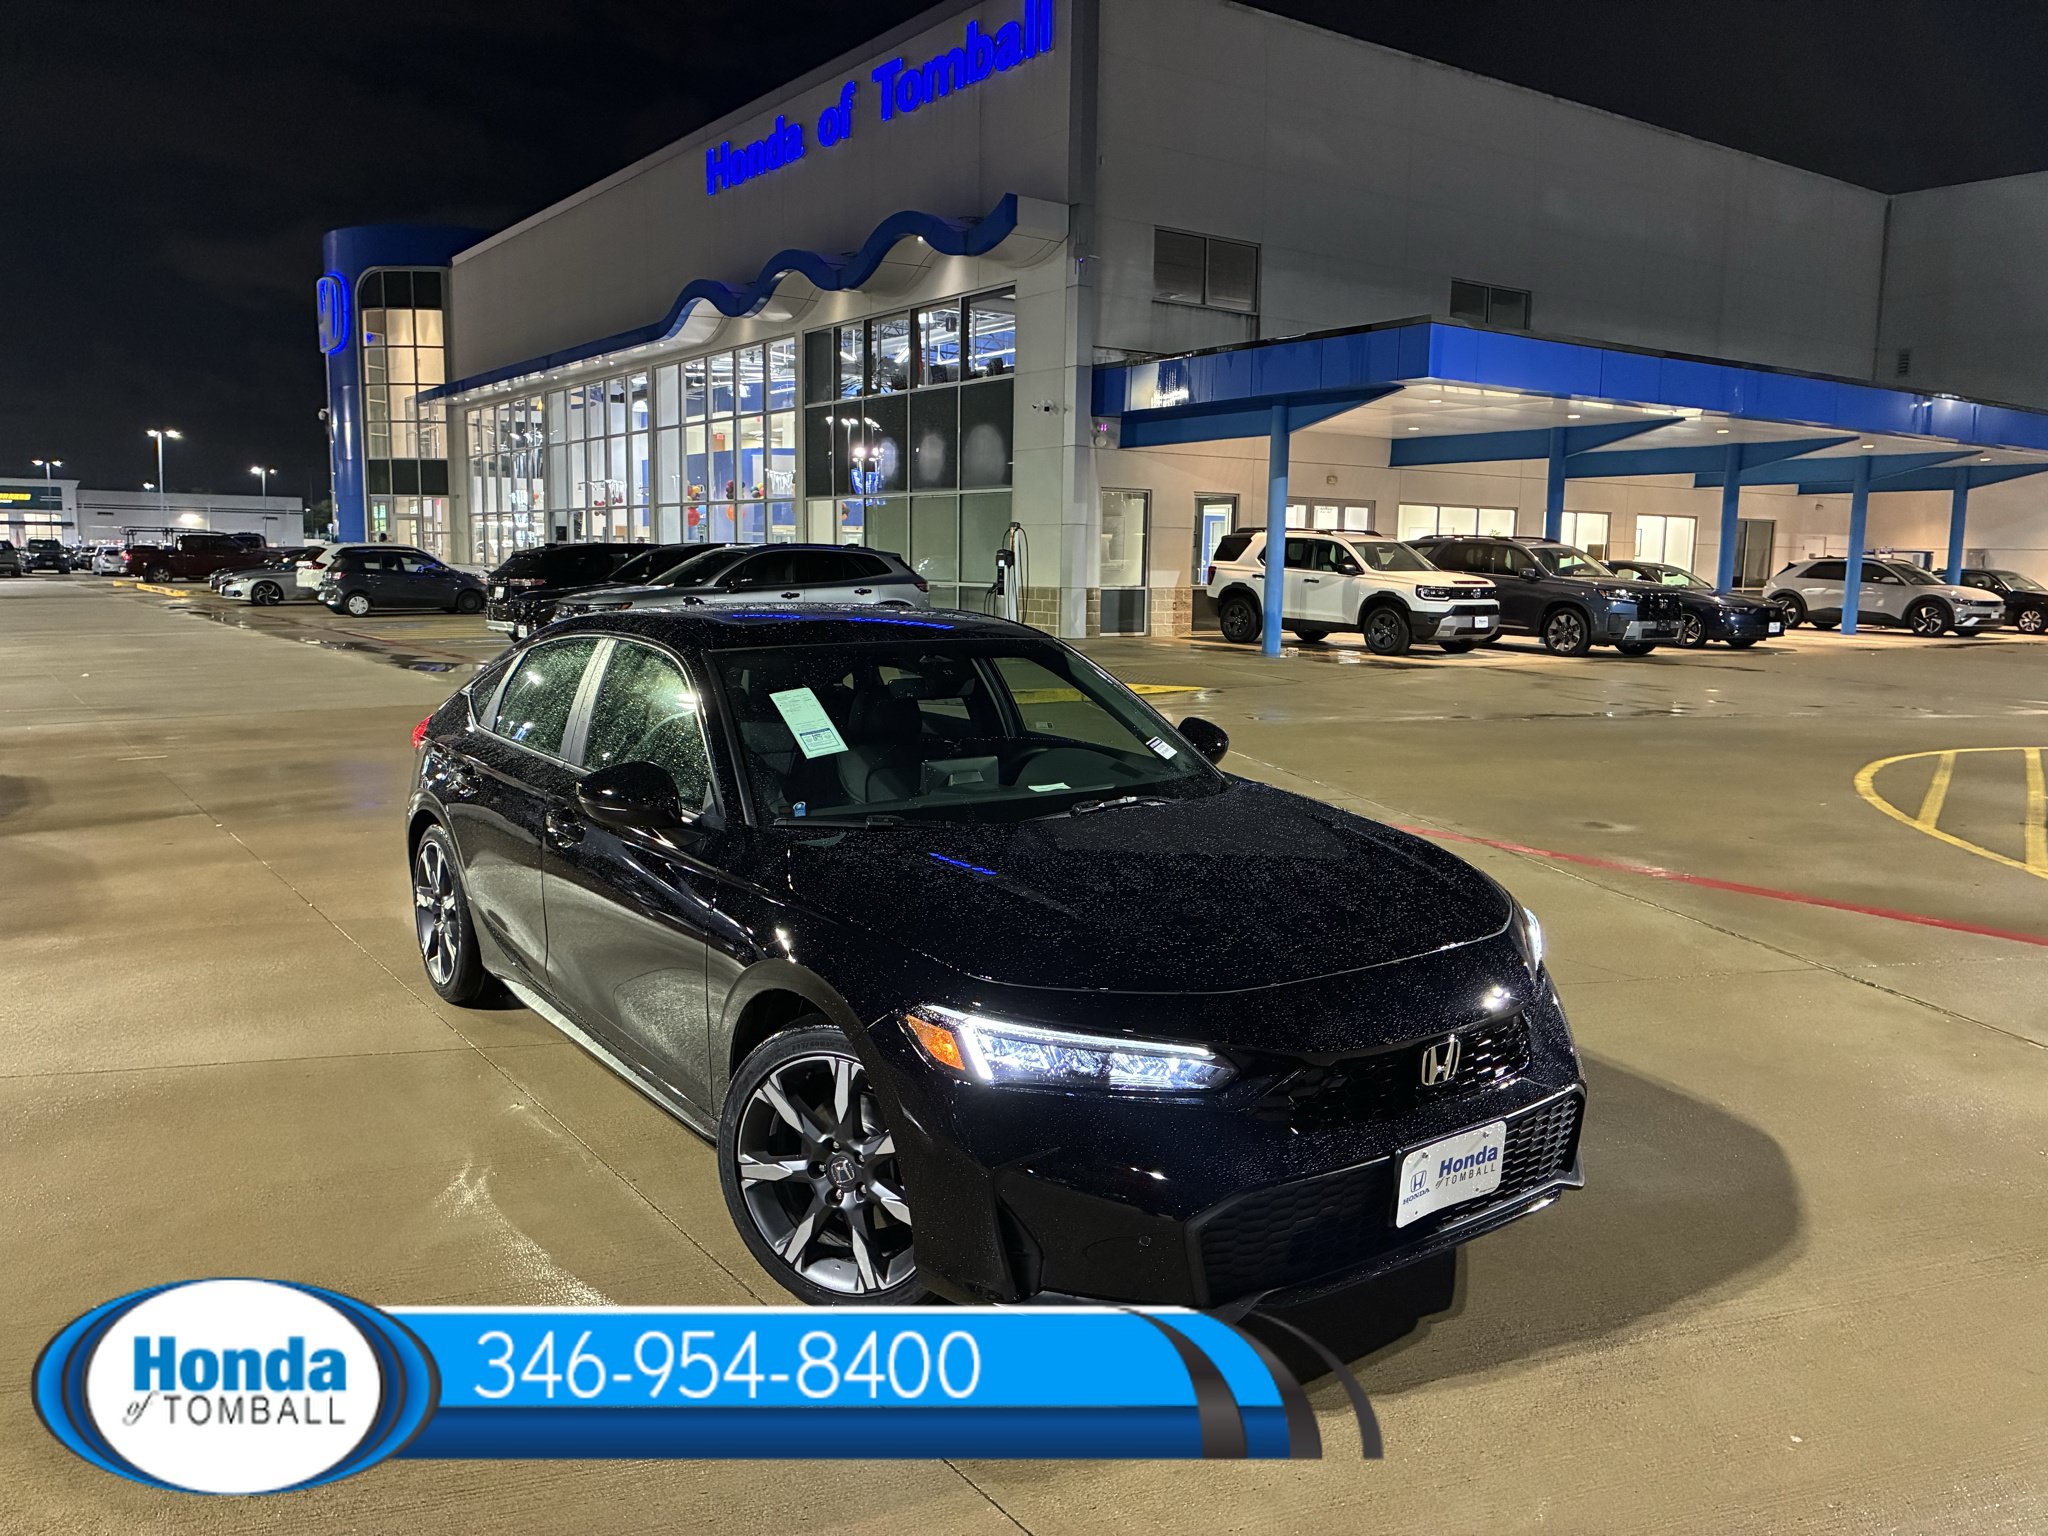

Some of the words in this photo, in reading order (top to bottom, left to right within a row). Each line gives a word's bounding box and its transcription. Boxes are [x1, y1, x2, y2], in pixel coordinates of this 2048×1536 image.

[706, 115, 804, 196] Honda
[817, 80, 856, 148] of
[871, 0, 1053, 122] Tomball
[1438, 1145, 1498, 1178] Honda
[1445, 1163, 1496, 1187] TOMBALL
[1402, 1187, 1430, 1205] HONDA
